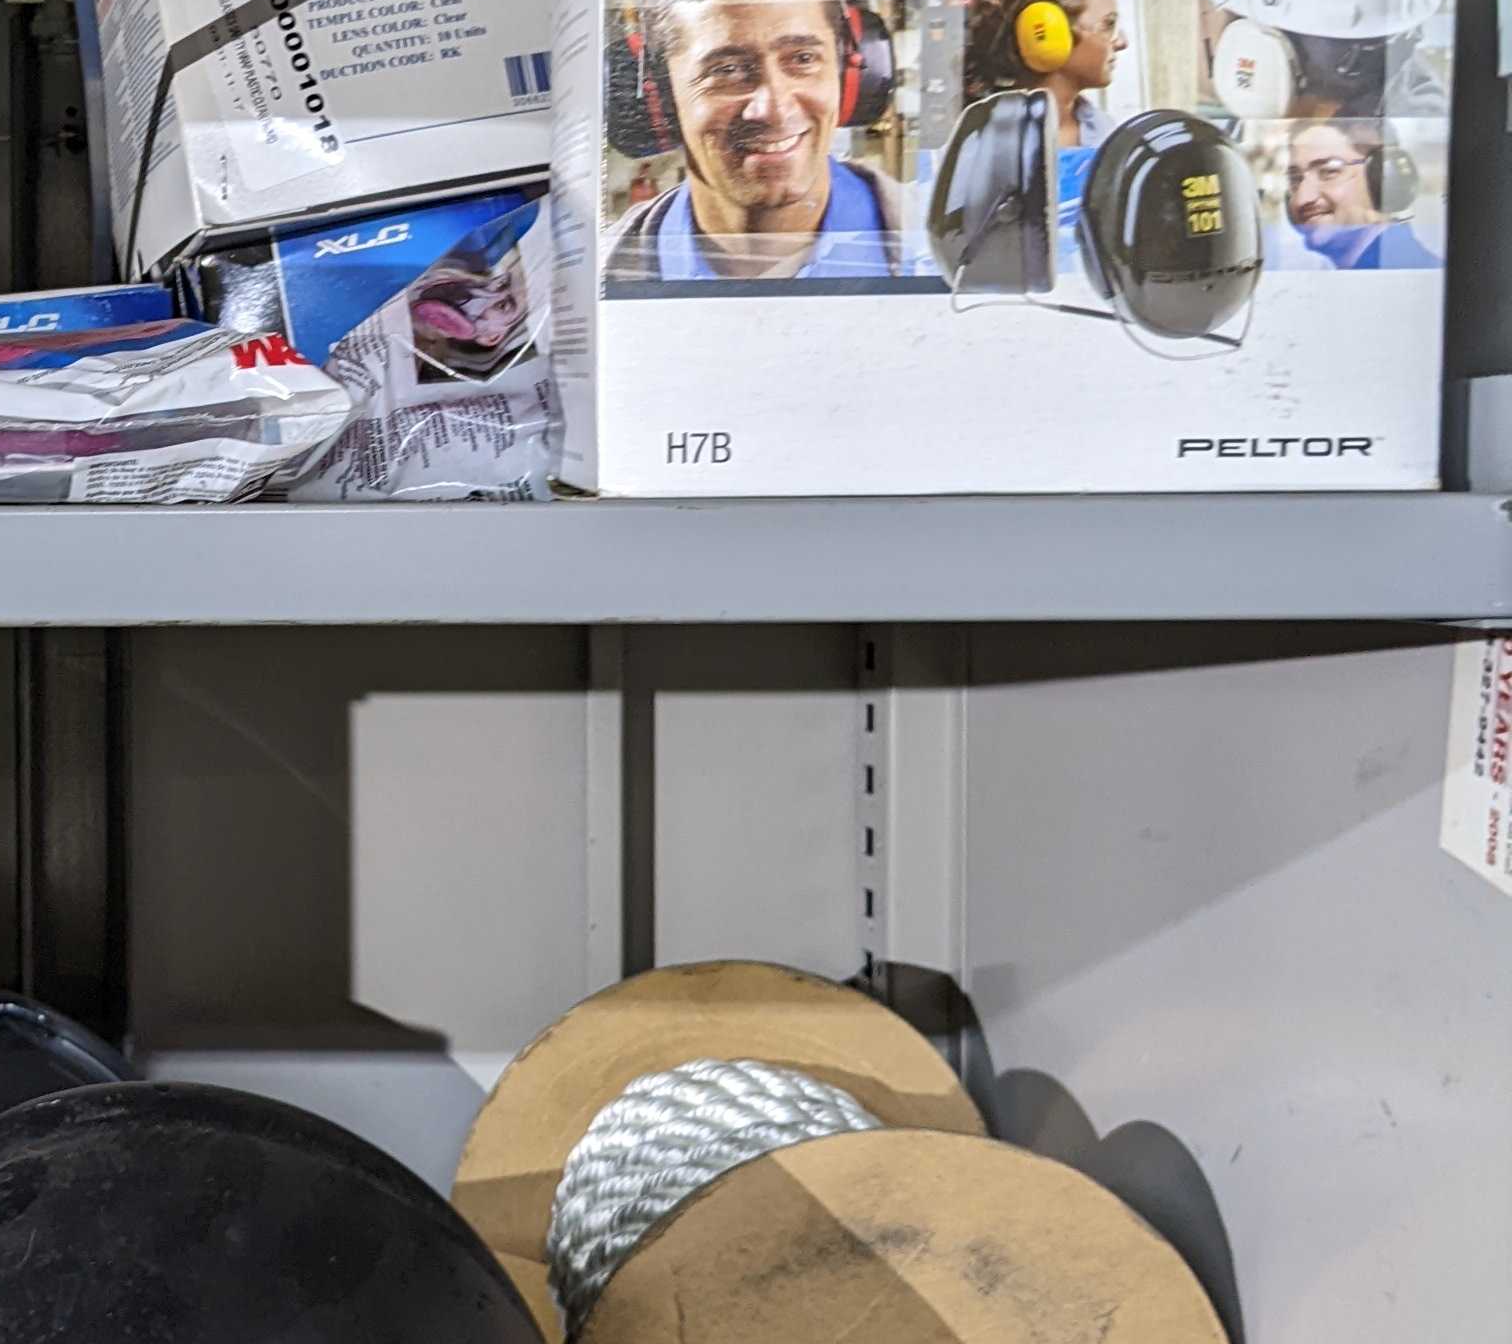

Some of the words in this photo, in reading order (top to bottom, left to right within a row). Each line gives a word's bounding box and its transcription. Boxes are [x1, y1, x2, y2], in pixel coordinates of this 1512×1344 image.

[306, 8, 366, 31] TEMPLE
[368, 0, 425, 19] COLOR:
[332, 26, 369, 44] LENS
[371, 17, 428, 36] COLOR:
[433, 11, 468, 25] Clear
[351, 34, 432, 58] QUANTITY:
[454, 25, 487, 40] Units
[319, 59, 387, 81] DUCTION
[388, 50, 435, 68] CODE:
[1180, 174, 1221, 199] 3M
[1187, 209, 1223, 233] 101
[314, 222, 412, 259] XLC
[665, 431, 733, 465] H7B
[1176, 436, 1374, 459] PELTOR
